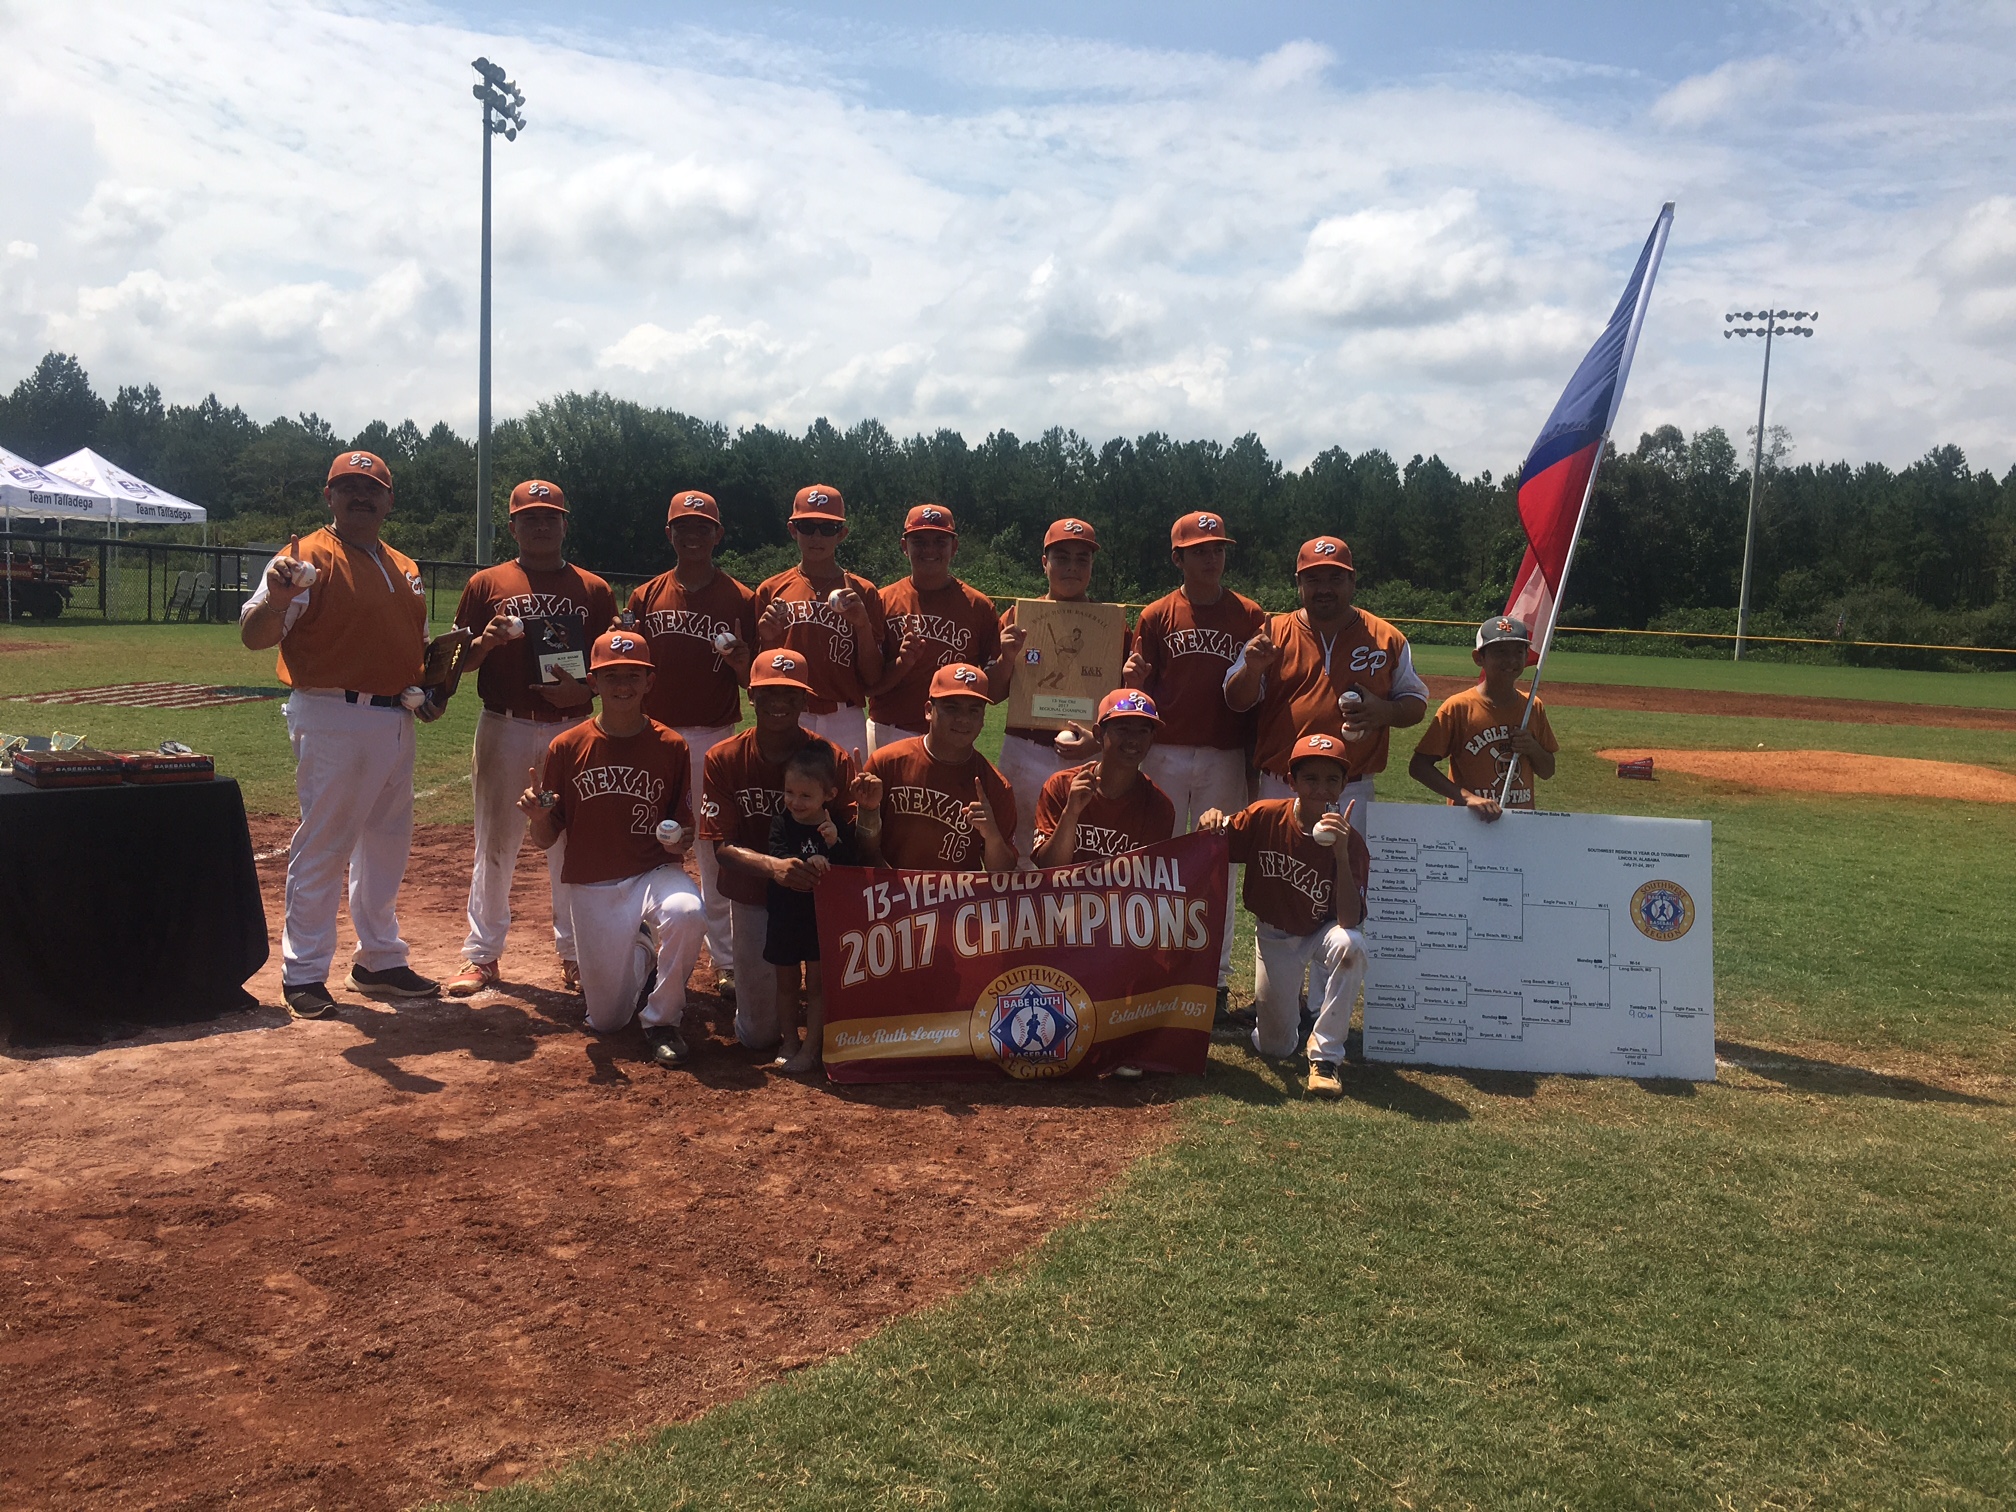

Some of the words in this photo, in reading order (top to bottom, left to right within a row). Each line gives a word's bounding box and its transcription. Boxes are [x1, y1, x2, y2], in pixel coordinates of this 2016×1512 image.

[349, 453, 373, 469] EP
[528, 482, 550, 497] EP
[807, 490, 829, 507] EP
[29, 490, 52, 504] Team
[54, 493, 93, 511] Talladega
[683, 494, 705, 509] EP
[136, 503, 156, 516] Team
[157, 506, 192, 522] Talladega
[921, 507, 942, 522] EP
[1063, 520, 1084, 534] EP
[1197, 515, 1218, 530] EP
[1314, 540, 1336, 555] EP
[645, 610, 730, 641] TEXAS
[886, 614, 972, 651] TEXAS
[610, 636, 634, 653] EP
[829, 634, 854, 668] 12
[771, 654, 796, 673] EP
[1350, 645, 1387, 676] EP
[953, 666, 978, 685] EP
[1081, 666, 1103, 678] K&K
[1308, 734, 1333, 750] EP
[1465, 725, 1510, 756] EAGLE
[572, 766, 665, 804] TEXAS
[735, 787, 787, 818] TEX
[889, 785, 975, 836] TEXAS
[937, 831, 971, 864] 16
[1074, 823, 1140, 857] EXA
[1258, 850, 1334, 904] TEXAS
[863, 870, 1043, 922] 13-YEAR-OLD
[1052, 855, 1186, 894] REGIONAL
[1640, 882, 1687, 898] SOUTHWEST
[840, 910, 939, 988] 2017
[952, 891, 1209, 957] CHAMPIONS
[1644, 926, 1682, 939] REGION
[987, 968, 1082, 1000] SOUTHWEST
[1003, 998, 1030, 1009] BABE
[1033, 996, 1061, 1007] RUTH
[1108, 1001, 1178, 1025] Established
[835, 1028, 871, 1047] Babe
[872, 1027, 909, 1044] Ruth
[909, 1025, 961, 1046] League
[1001, 1059, 1070, 1078] EGION
